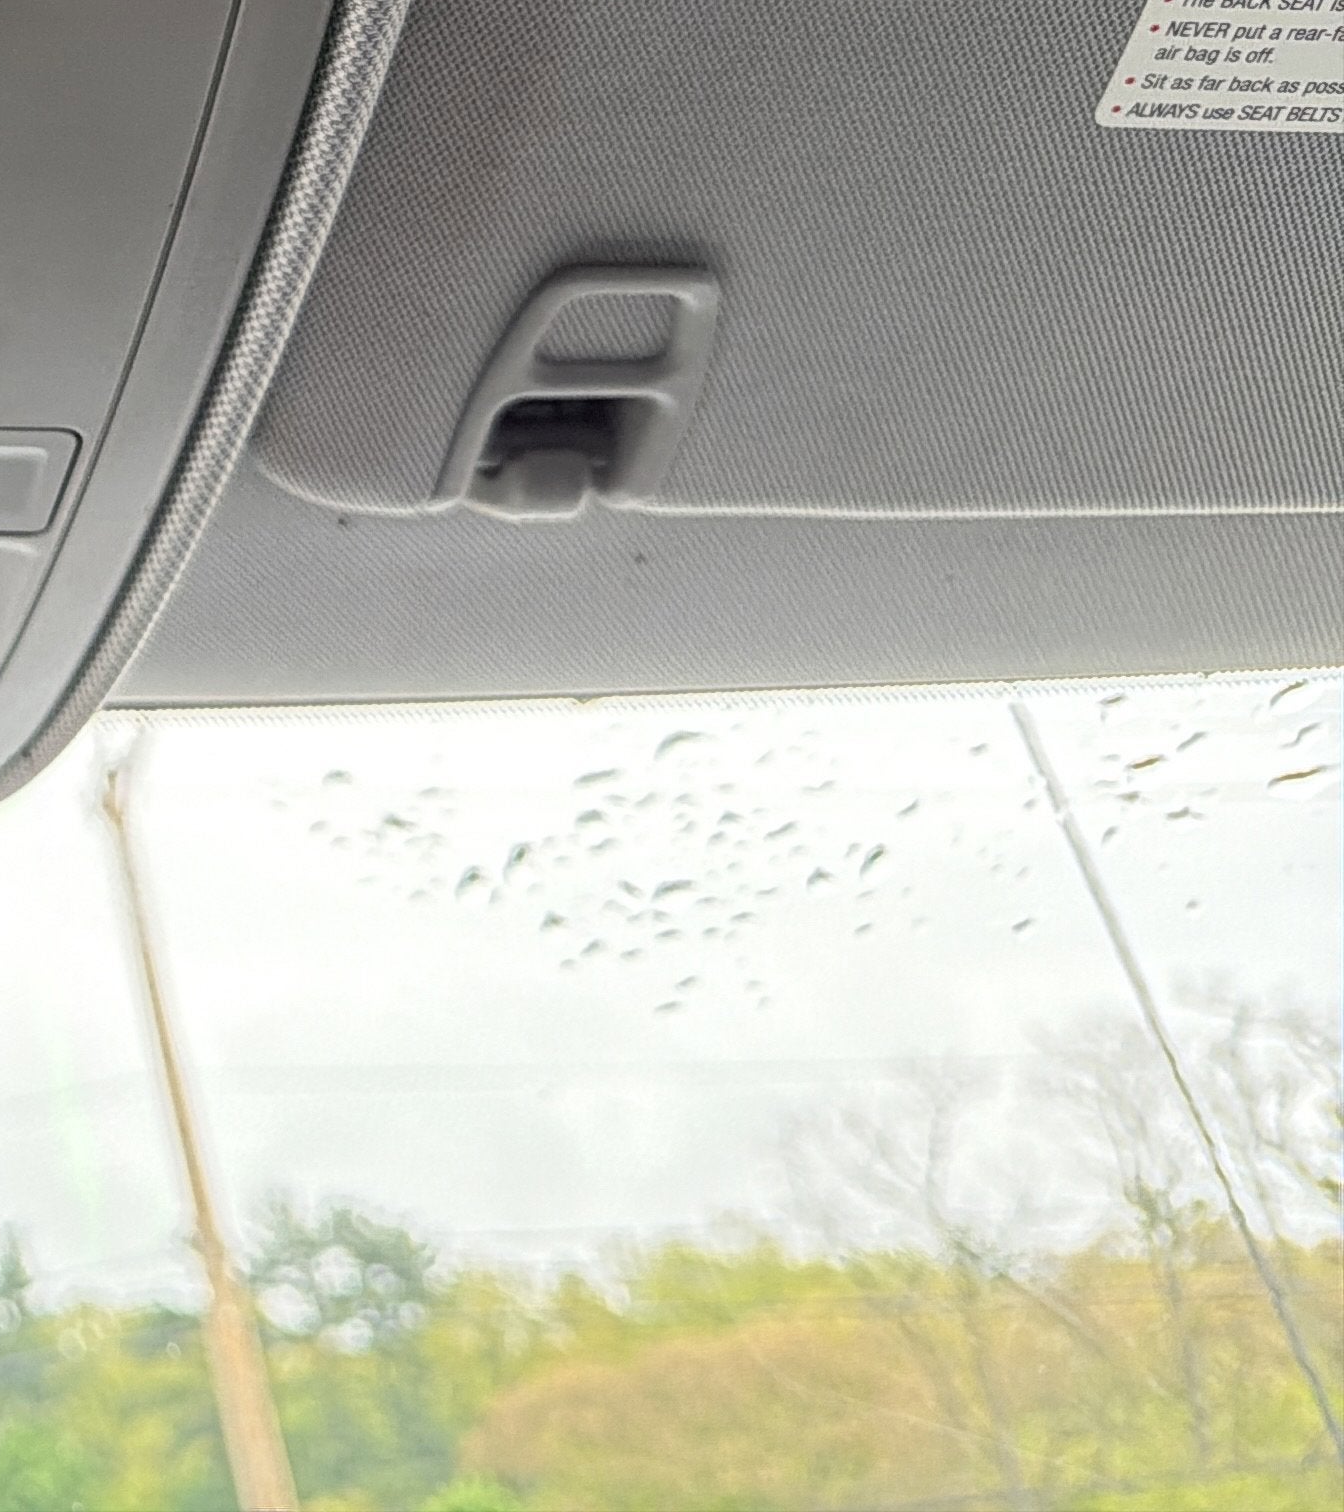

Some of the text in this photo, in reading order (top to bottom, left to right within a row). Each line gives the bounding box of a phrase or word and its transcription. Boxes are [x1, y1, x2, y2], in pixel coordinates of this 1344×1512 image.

[1165, 21, 1231, 38] NEVER
[1232, 23, 1267, 43] put
[1269, 27, 1281, 40] a
[1154, 45, 1275, 65] air bag is off.
[1140, 73, 1344, 97] Sit as far back as poss
[1125, 102, 1343, 123] ALWAYS use SEAT BELTS
